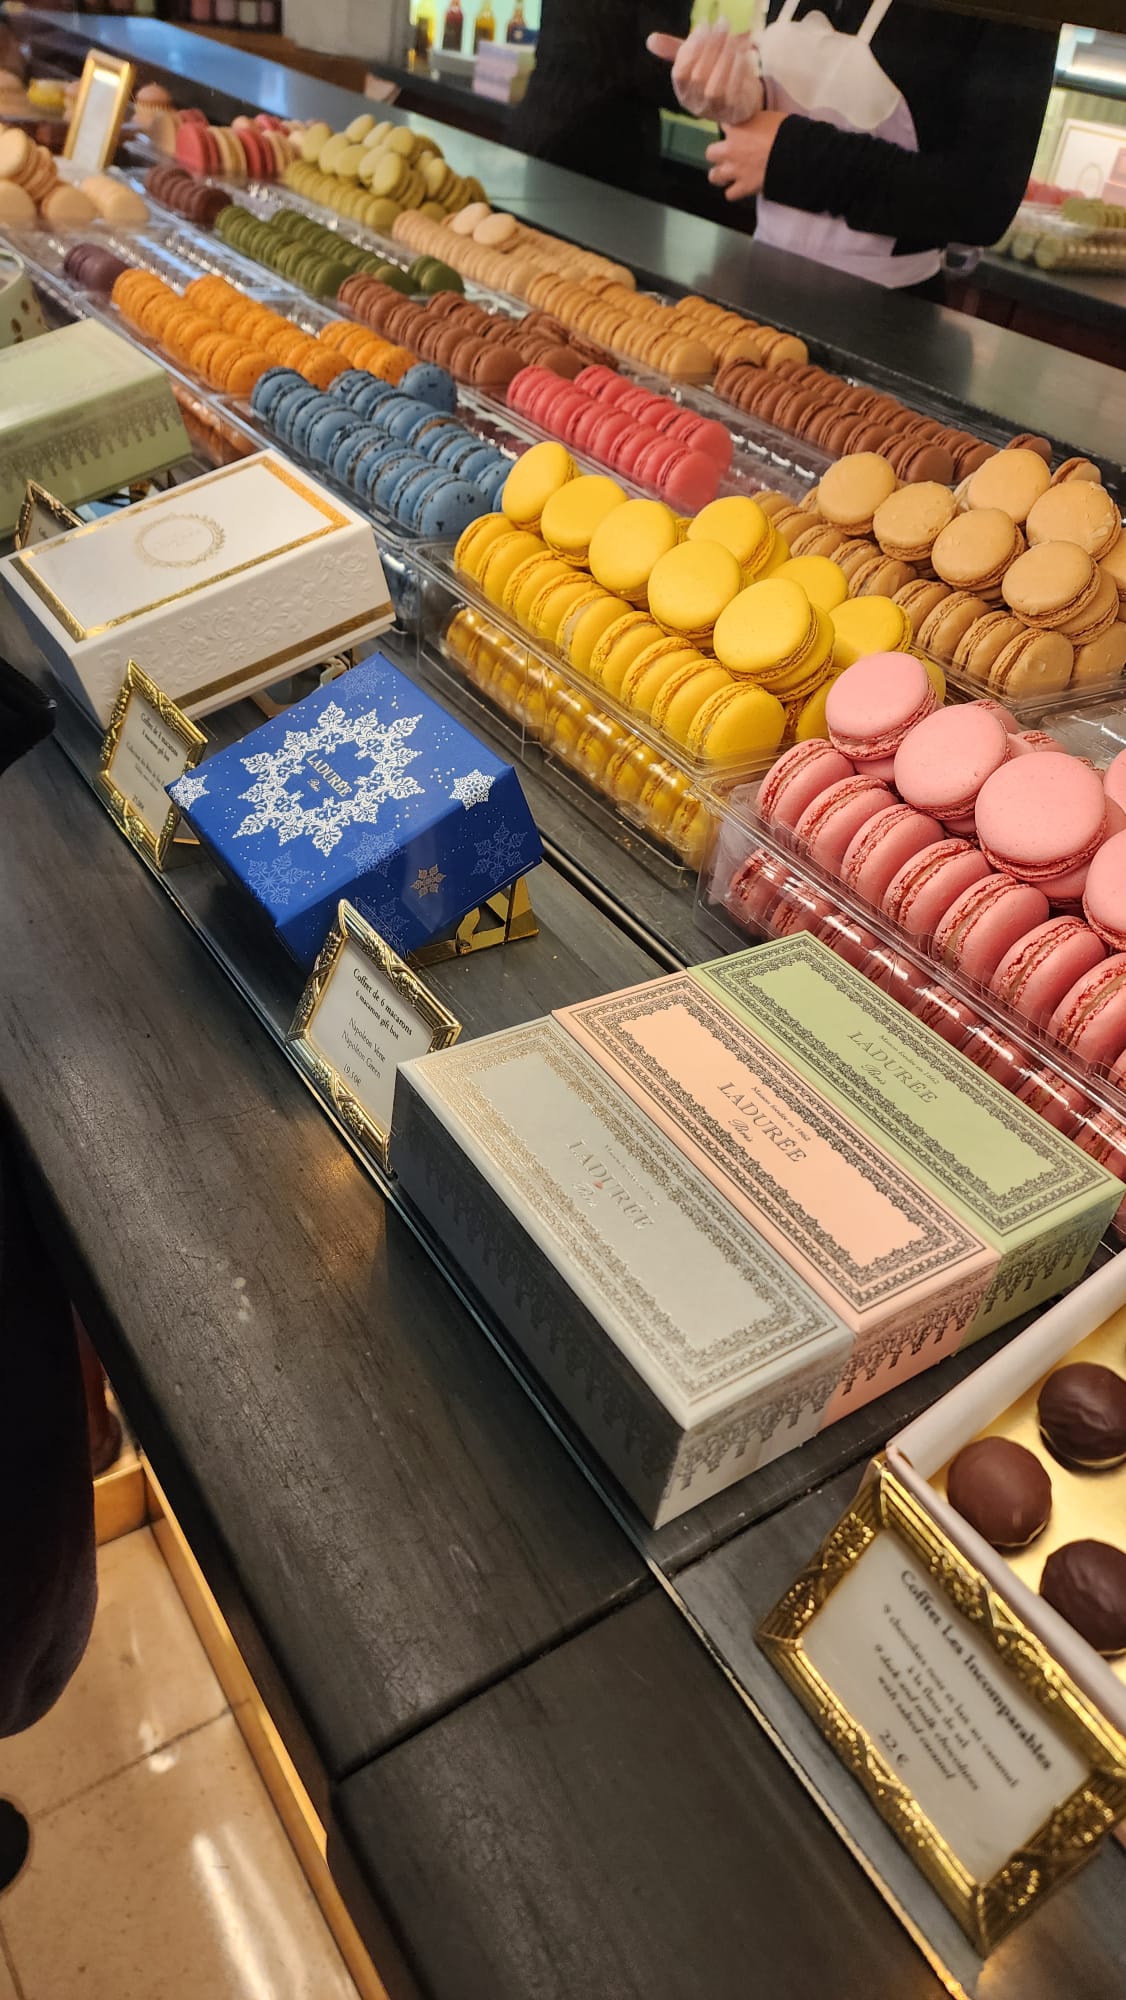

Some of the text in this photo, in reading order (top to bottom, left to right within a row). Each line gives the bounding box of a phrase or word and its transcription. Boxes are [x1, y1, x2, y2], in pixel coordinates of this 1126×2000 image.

[305, 751, 352, 798] LADURÉE
[351, 966, 413, 1036] Coffret de 6 macarons
[358, 993, 382, 1021] macarons
[846, 1031, 938, 1106] LADURÉE
[860, 1062, 886, 1086] Paris
[717, 1081, 807, 1164] LADURÉE
[727, 1117, 753, 1143] Paris
[896, 1566, 1057, 1772] Coffret Les Incomparables
[876, 1727, 911, 1770] 22 €
